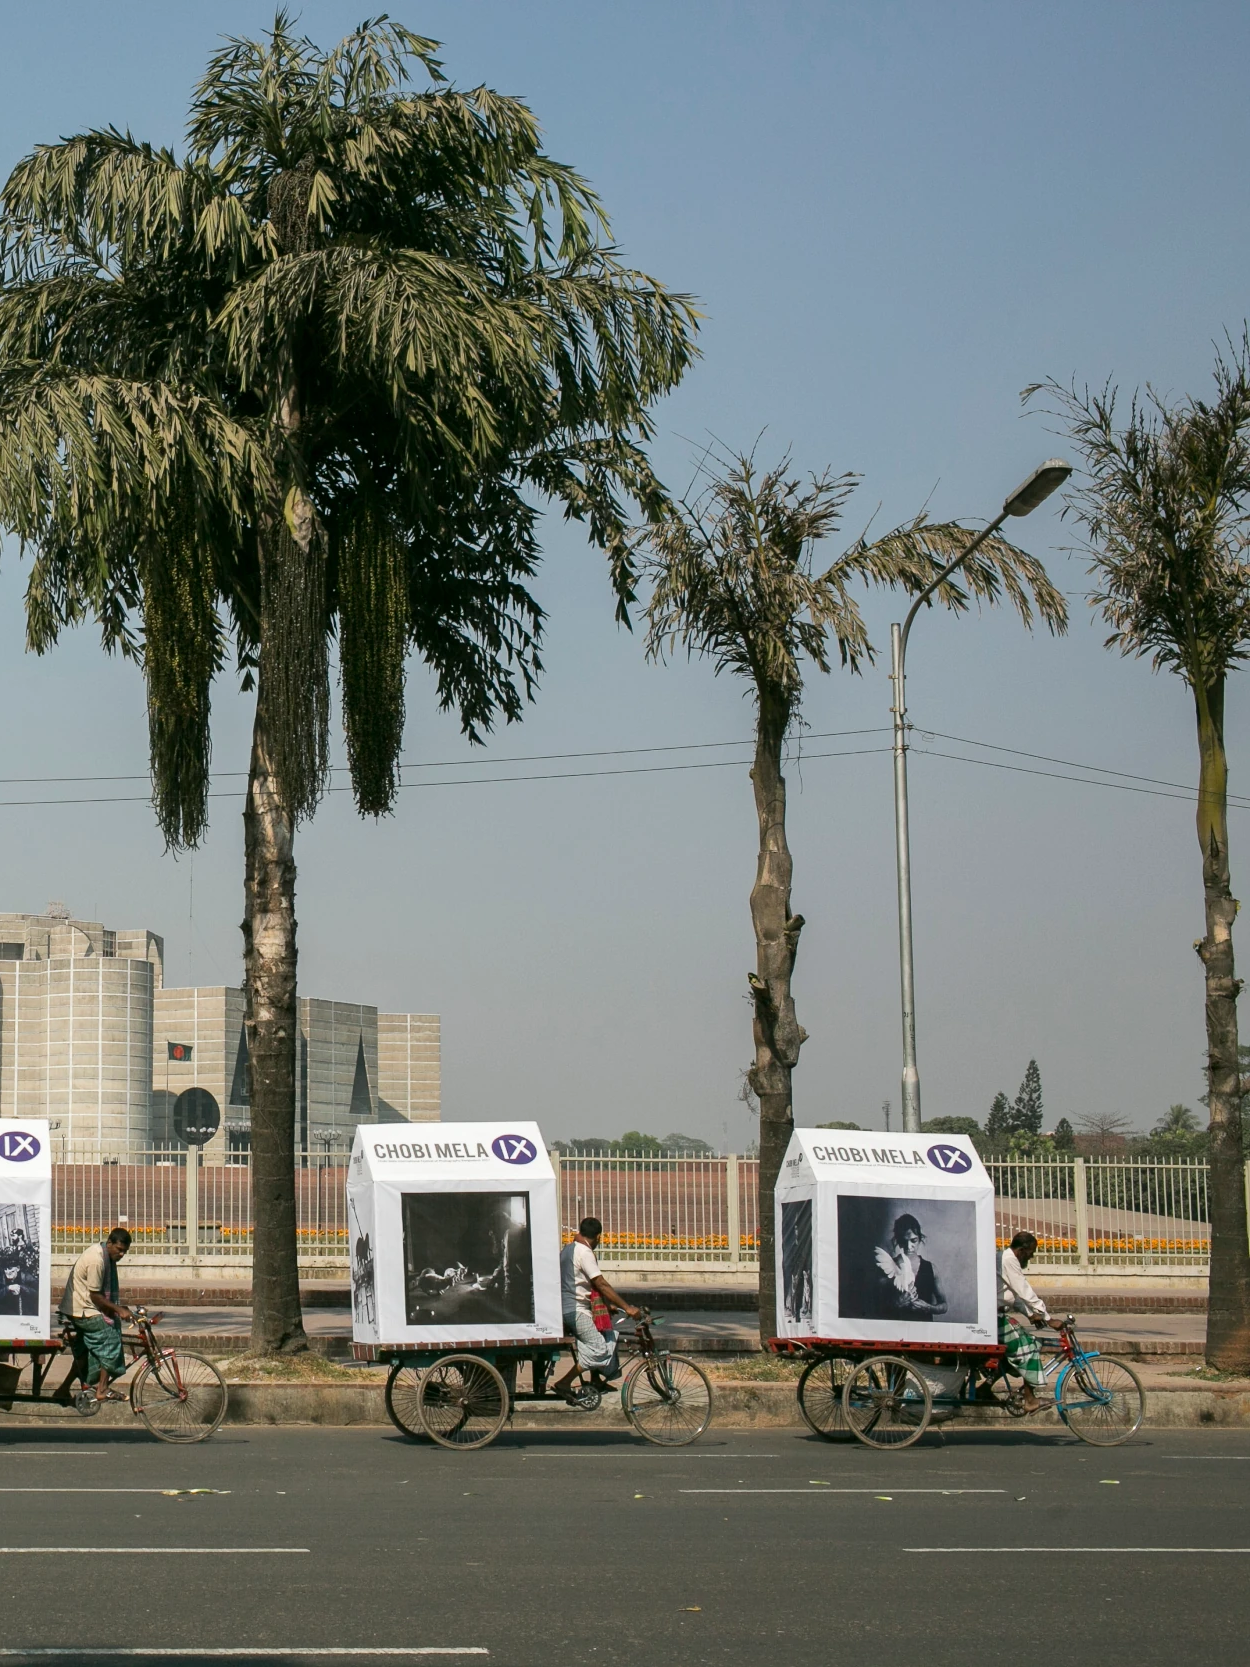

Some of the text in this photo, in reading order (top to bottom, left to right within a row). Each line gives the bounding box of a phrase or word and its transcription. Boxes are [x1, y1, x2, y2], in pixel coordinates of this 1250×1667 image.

[4, 1136, 34, 1156] IX
[373, 1139, 532, 1160] CHOBI MELA IX
[812, 1146, 871, 1163] CHOBI
[871, 1149, 926, 1165] MELA
[933, 1149, 968, 1168] IX
